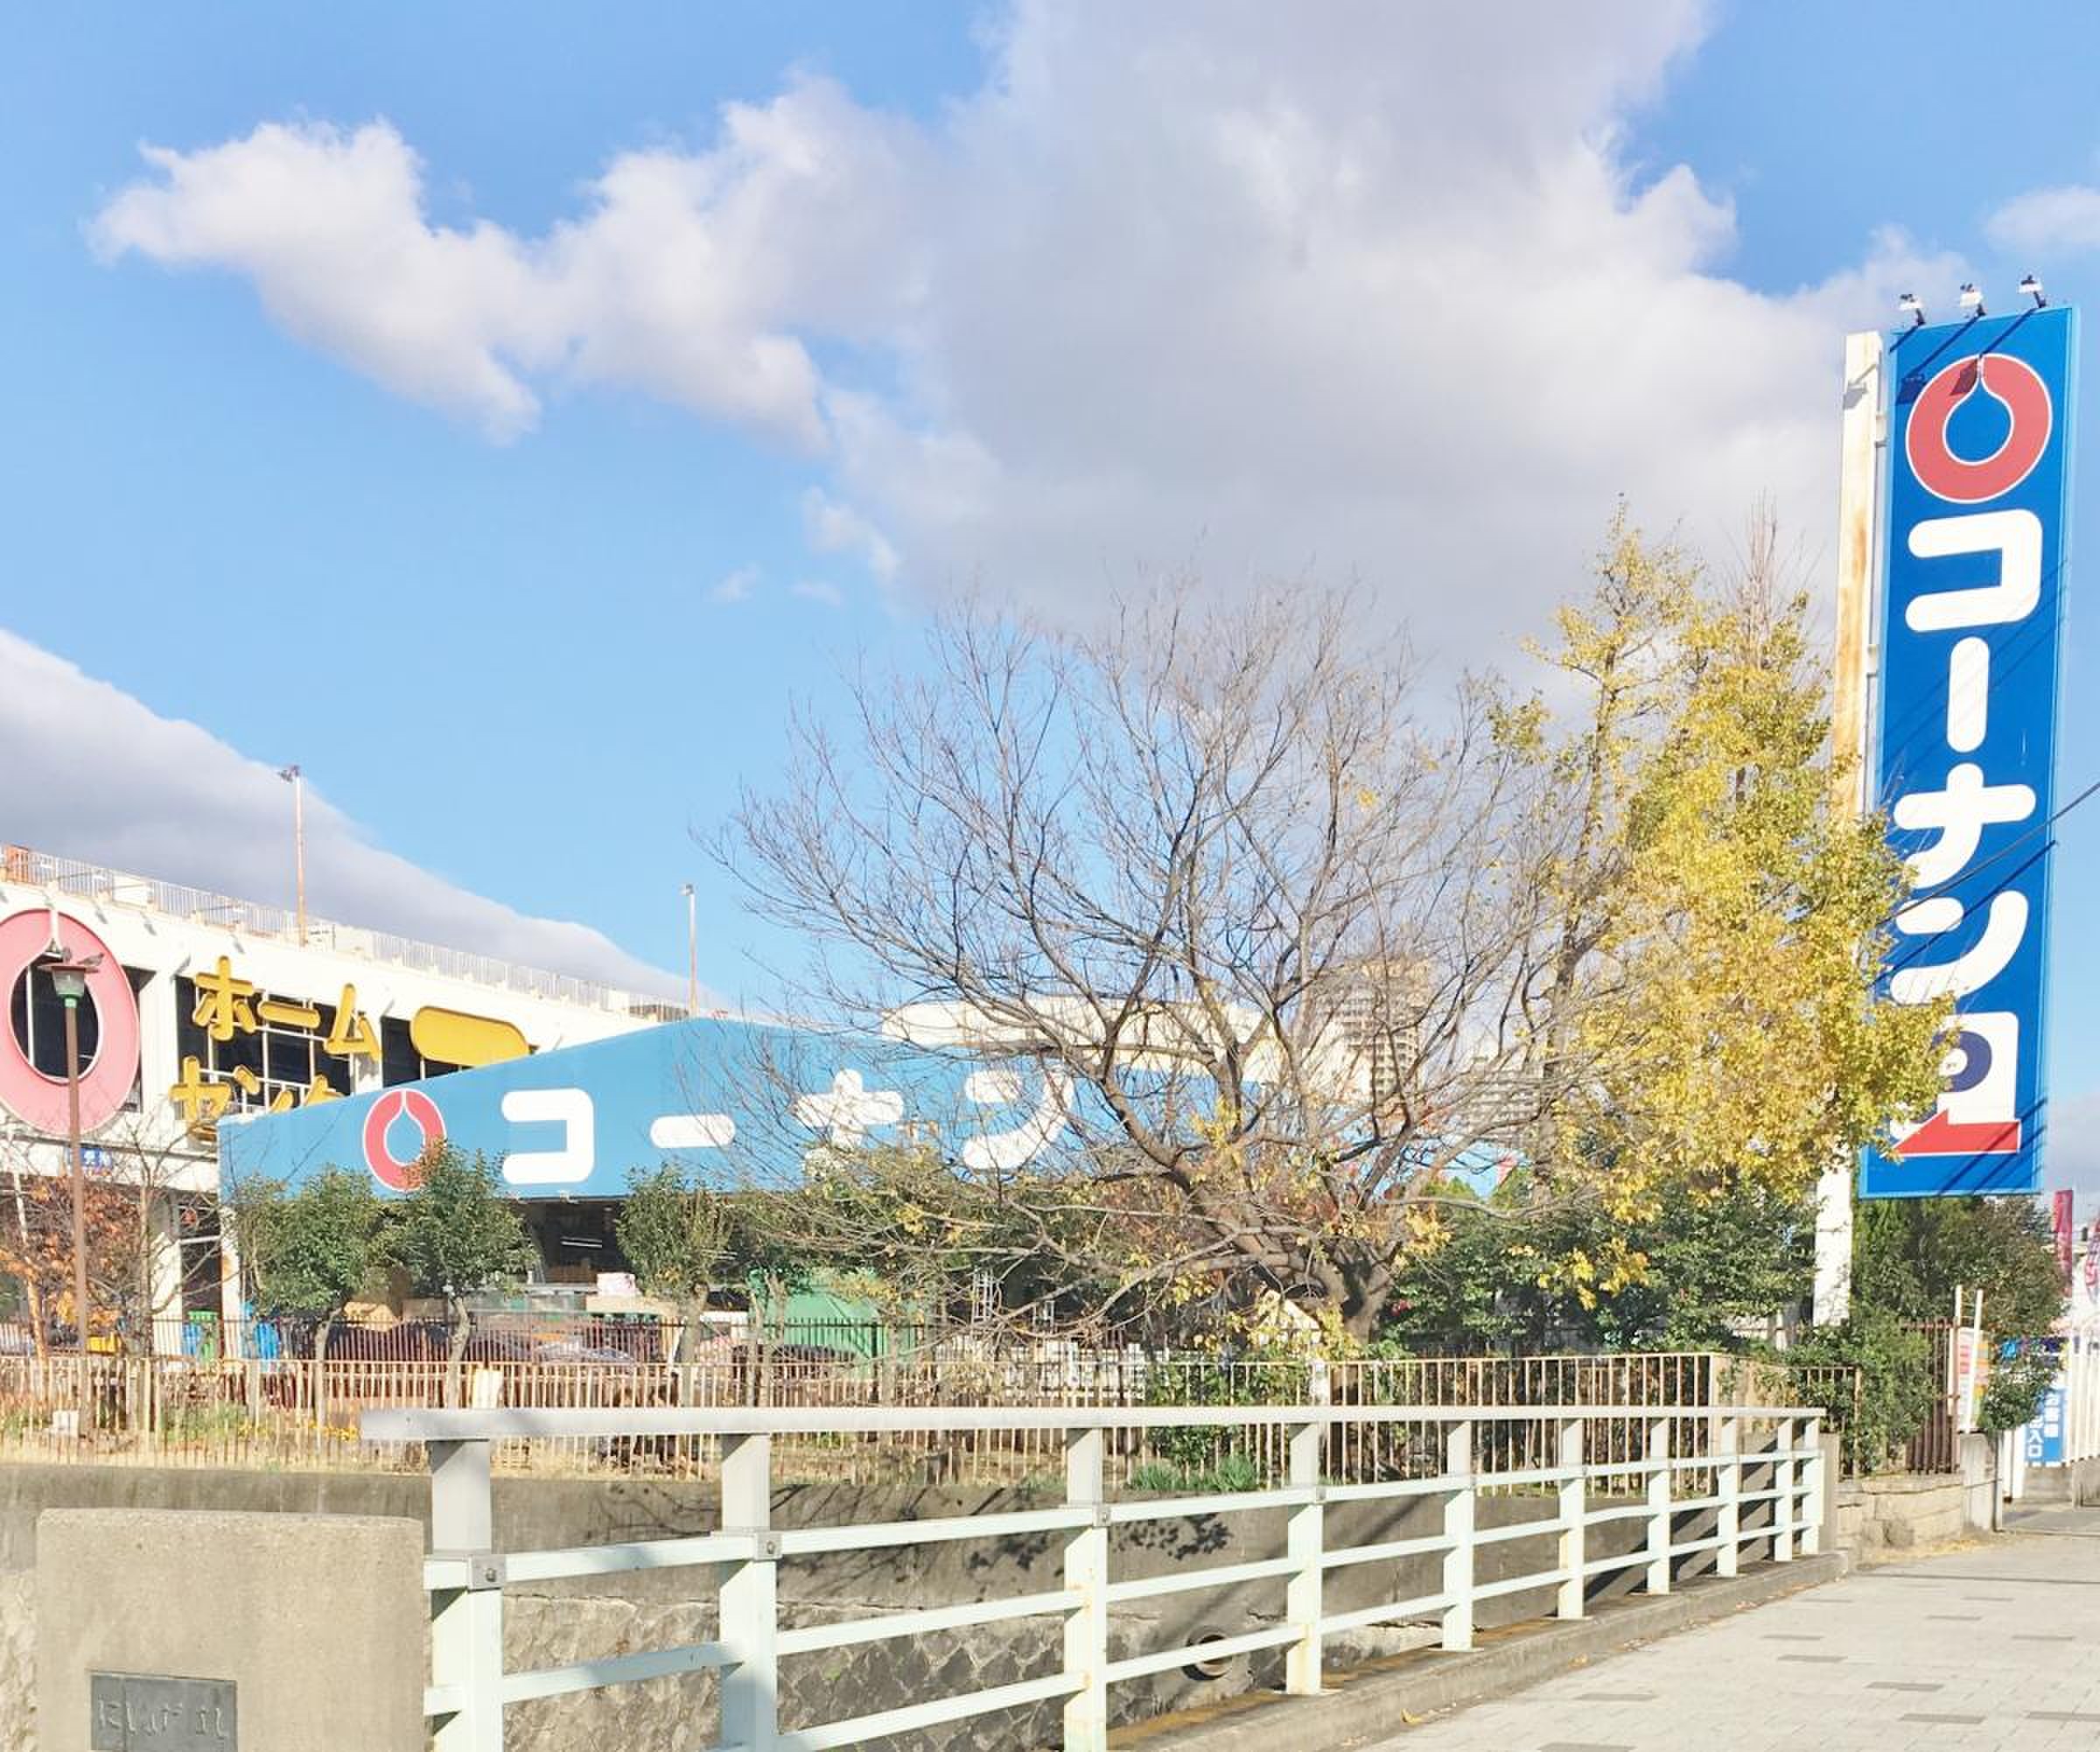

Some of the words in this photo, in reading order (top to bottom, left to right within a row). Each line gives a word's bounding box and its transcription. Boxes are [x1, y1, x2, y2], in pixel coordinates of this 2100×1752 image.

[1890, 508, 2043, 1005] コーナン
[192, 956, 382, 1062] ホーム
